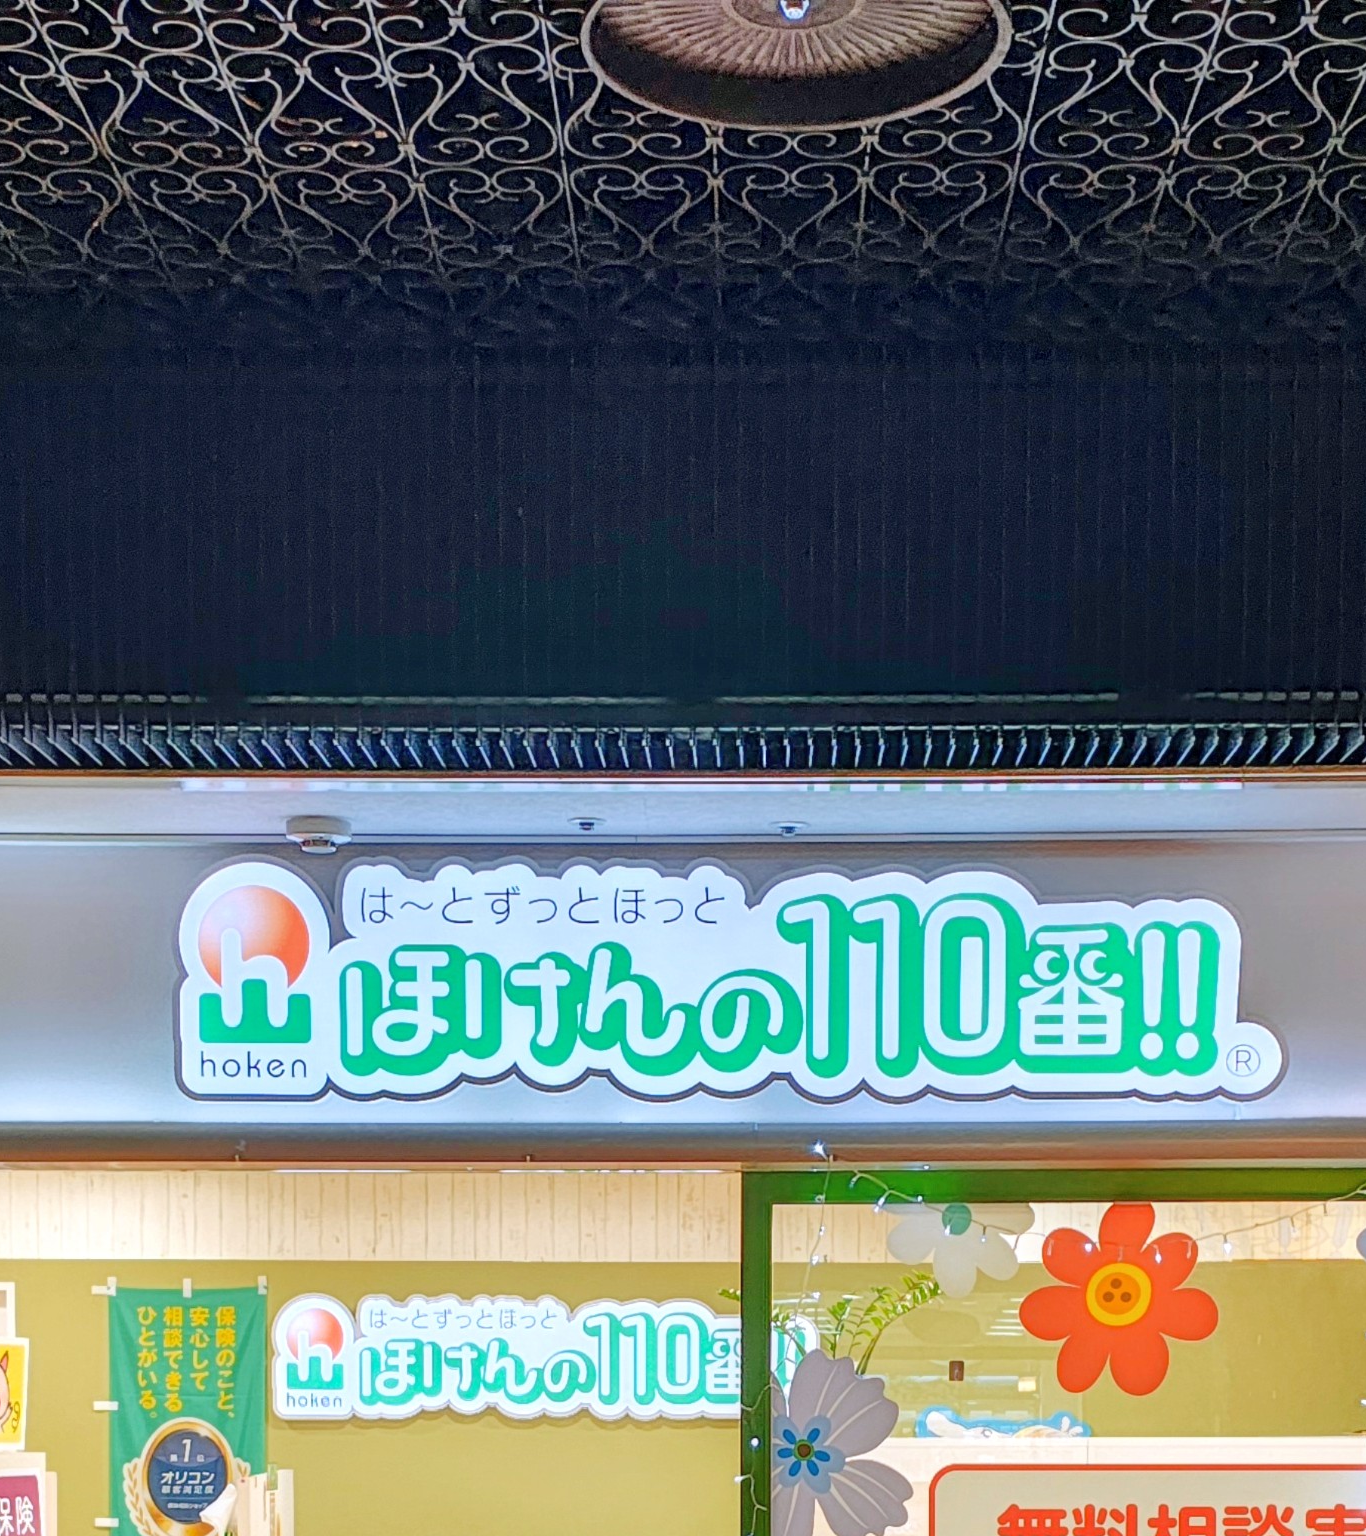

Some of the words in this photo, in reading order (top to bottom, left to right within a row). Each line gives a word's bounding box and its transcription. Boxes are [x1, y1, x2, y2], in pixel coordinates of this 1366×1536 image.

[200, 1050, 308, 1079] hoken
[162, 1305, 184, 1413] 相談できる
[189, 1306, 210, 1391] 安心して
[285, 1392, 344, 1408] hoken
[160, 1471, 216, 1485] オリコン
